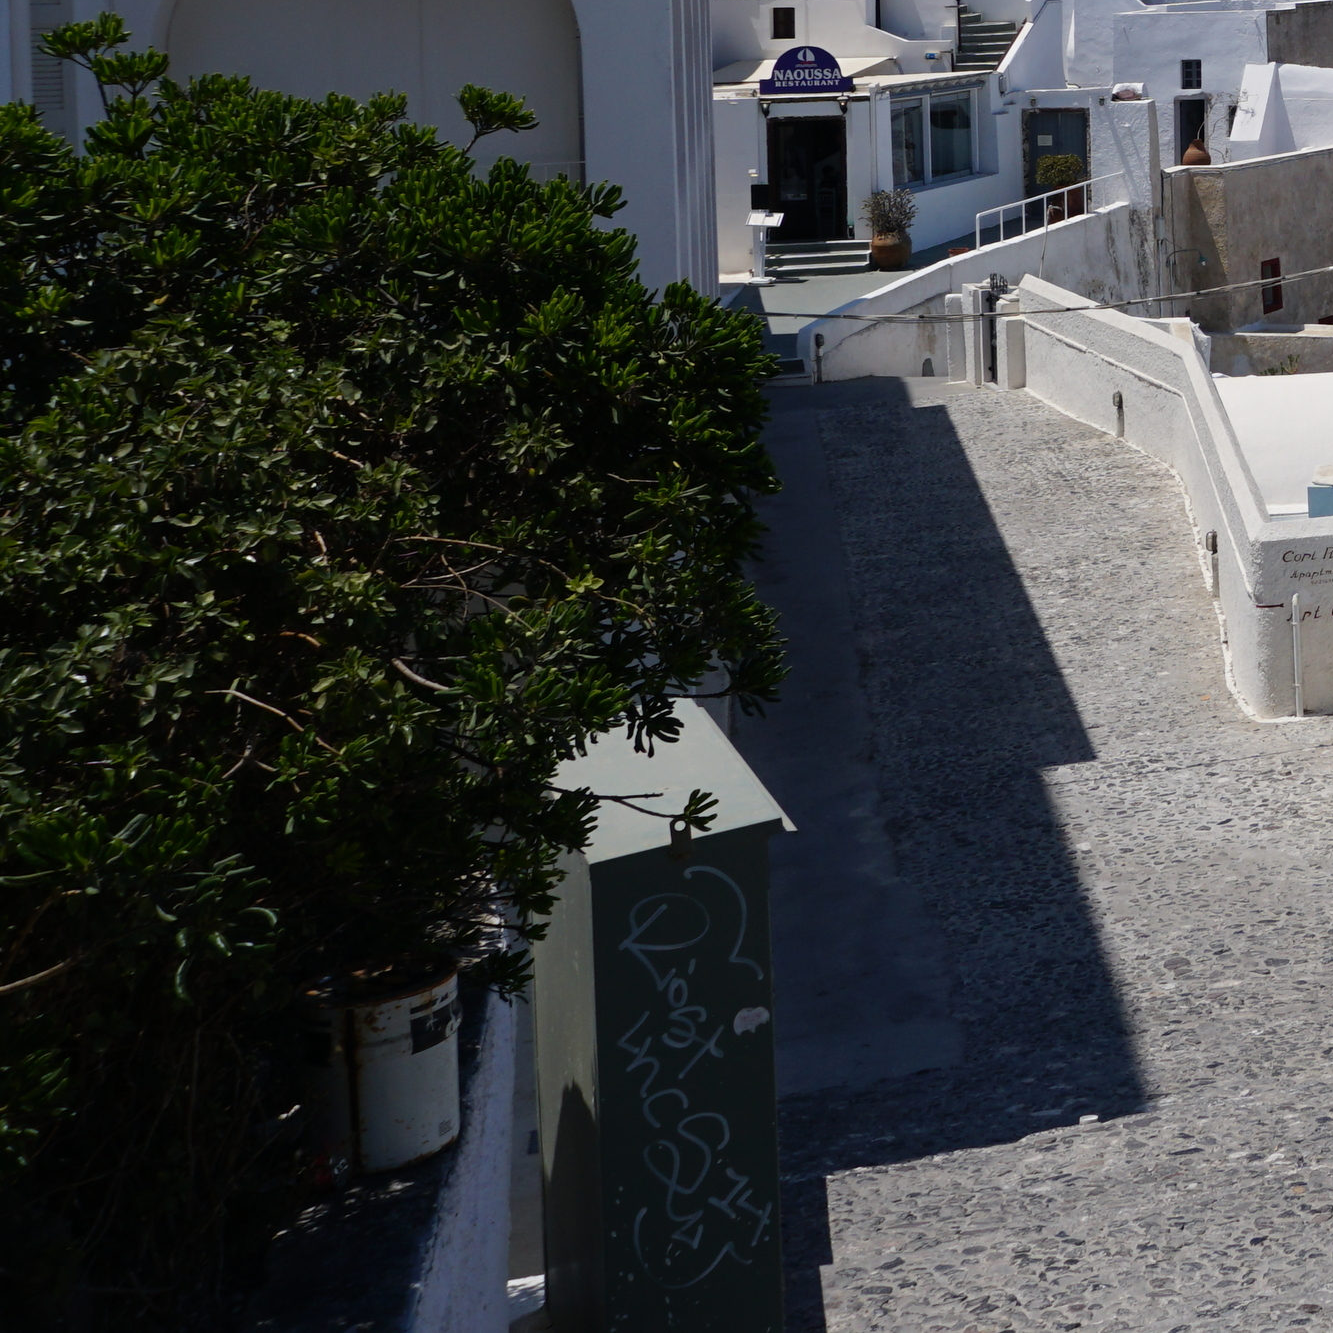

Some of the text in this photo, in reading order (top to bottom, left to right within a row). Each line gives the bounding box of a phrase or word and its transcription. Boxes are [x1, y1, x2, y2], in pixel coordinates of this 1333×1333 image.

[773, 68, 842, 81] NAOUSSA
[775, 79, 840, 87] RESTAURANT
[1286, 606, 1322, 622] rt
